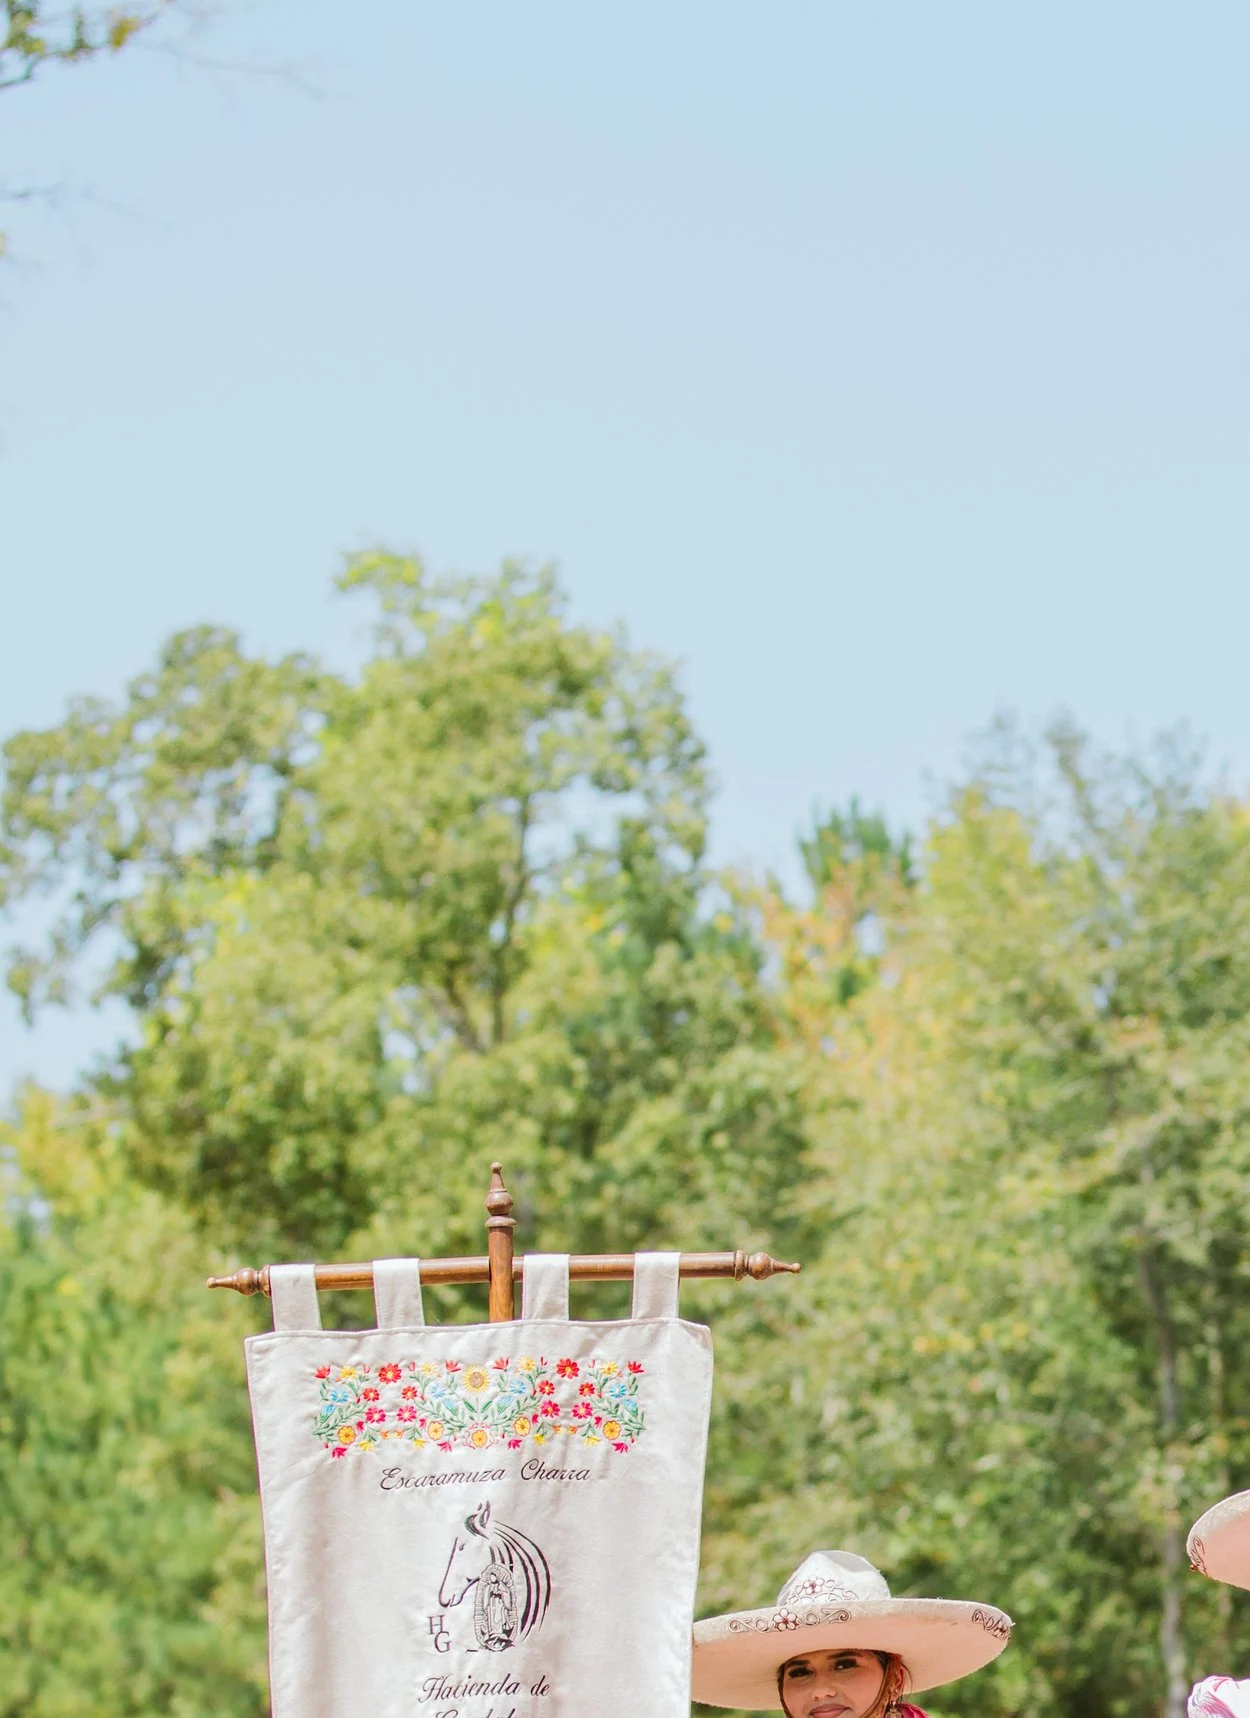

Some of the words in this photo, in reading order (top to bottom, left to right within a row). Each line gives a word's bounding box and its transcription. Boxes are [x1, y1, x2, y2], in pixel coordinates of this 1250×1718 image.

[379, 1467, 506, 1491] Escaramuza
[520, 1458, 592, 1481] Charra
[418, 1673, 521, 1703] Hacienda
[530, 1675, 550, 1697] de
